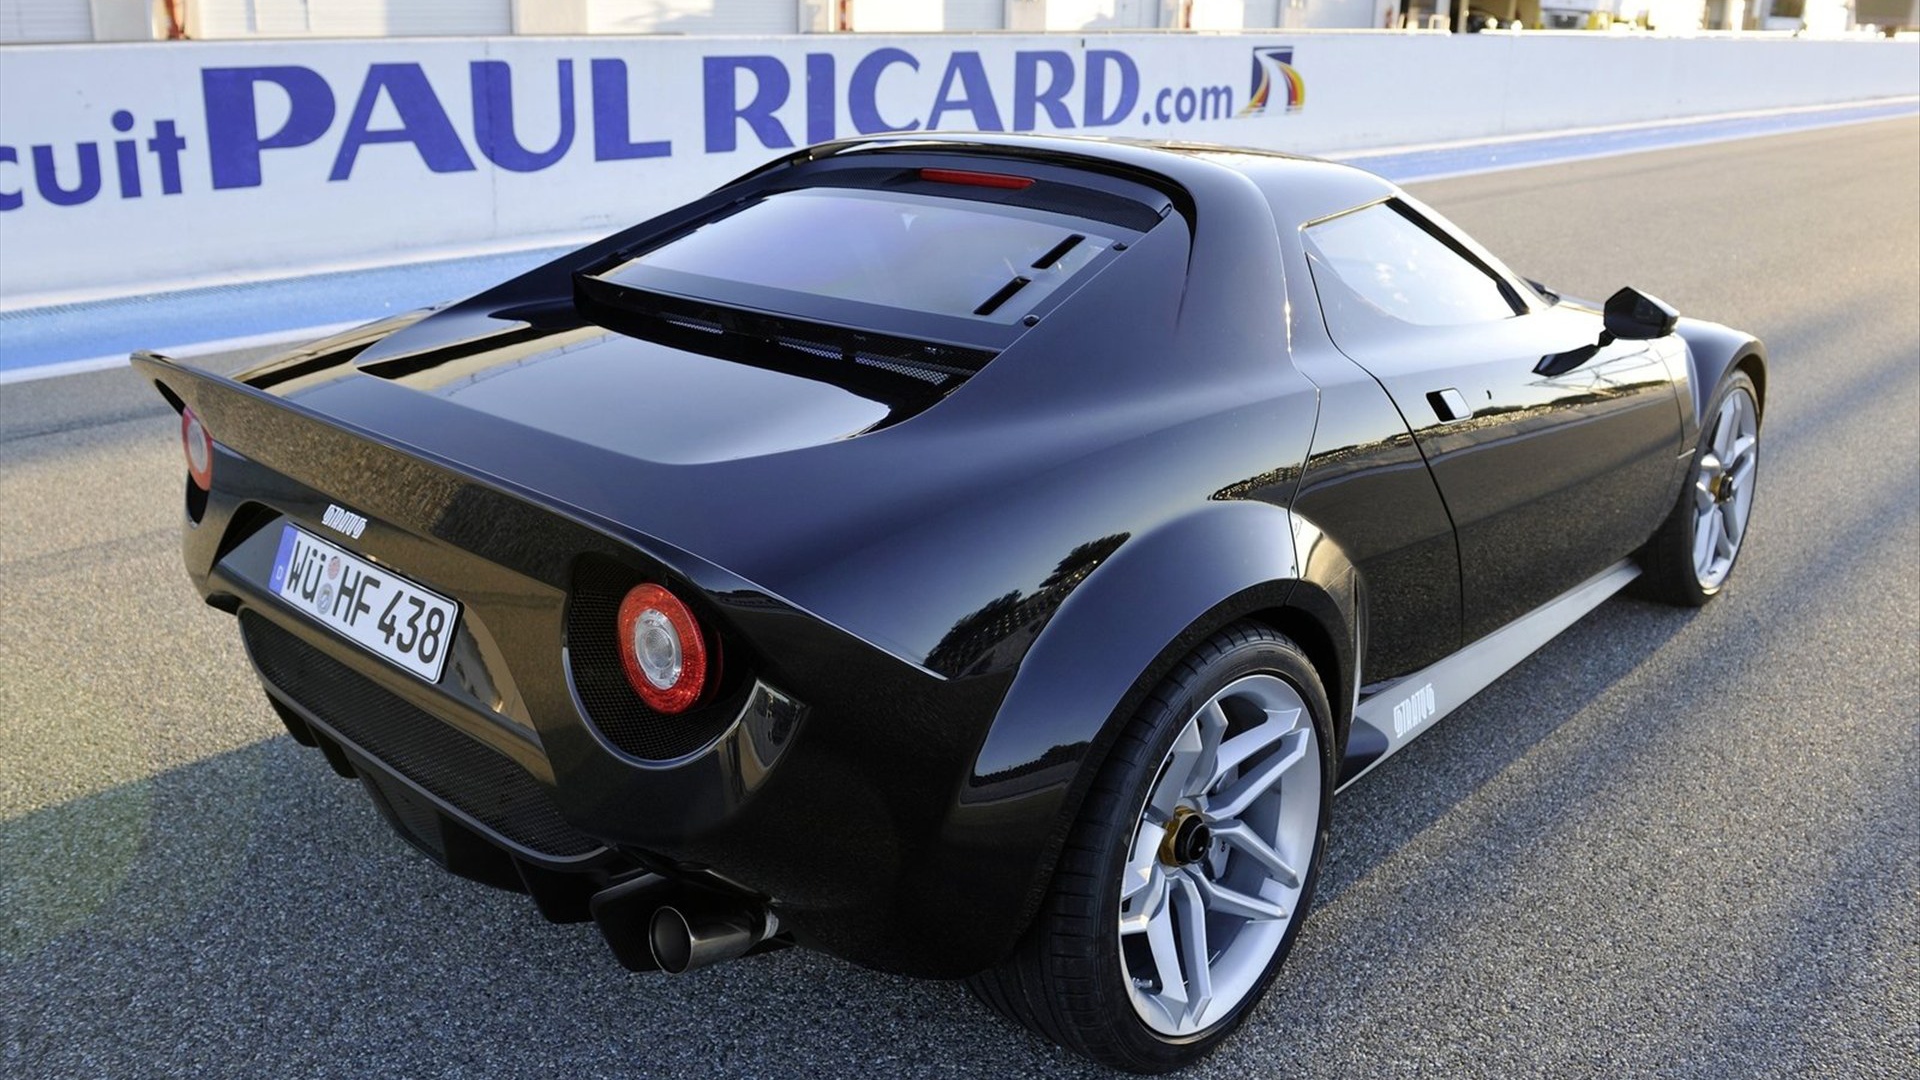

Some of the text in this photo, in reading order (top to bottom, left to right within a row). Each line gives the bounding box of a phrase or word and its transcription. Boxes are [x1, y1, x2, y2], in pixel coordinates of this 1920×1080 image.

[201, 59, 672, 191] PAUL
[275, 565, 284, 580] D
[332, 565, 381, 627] HF
[377, 590, 445, 664] 438
